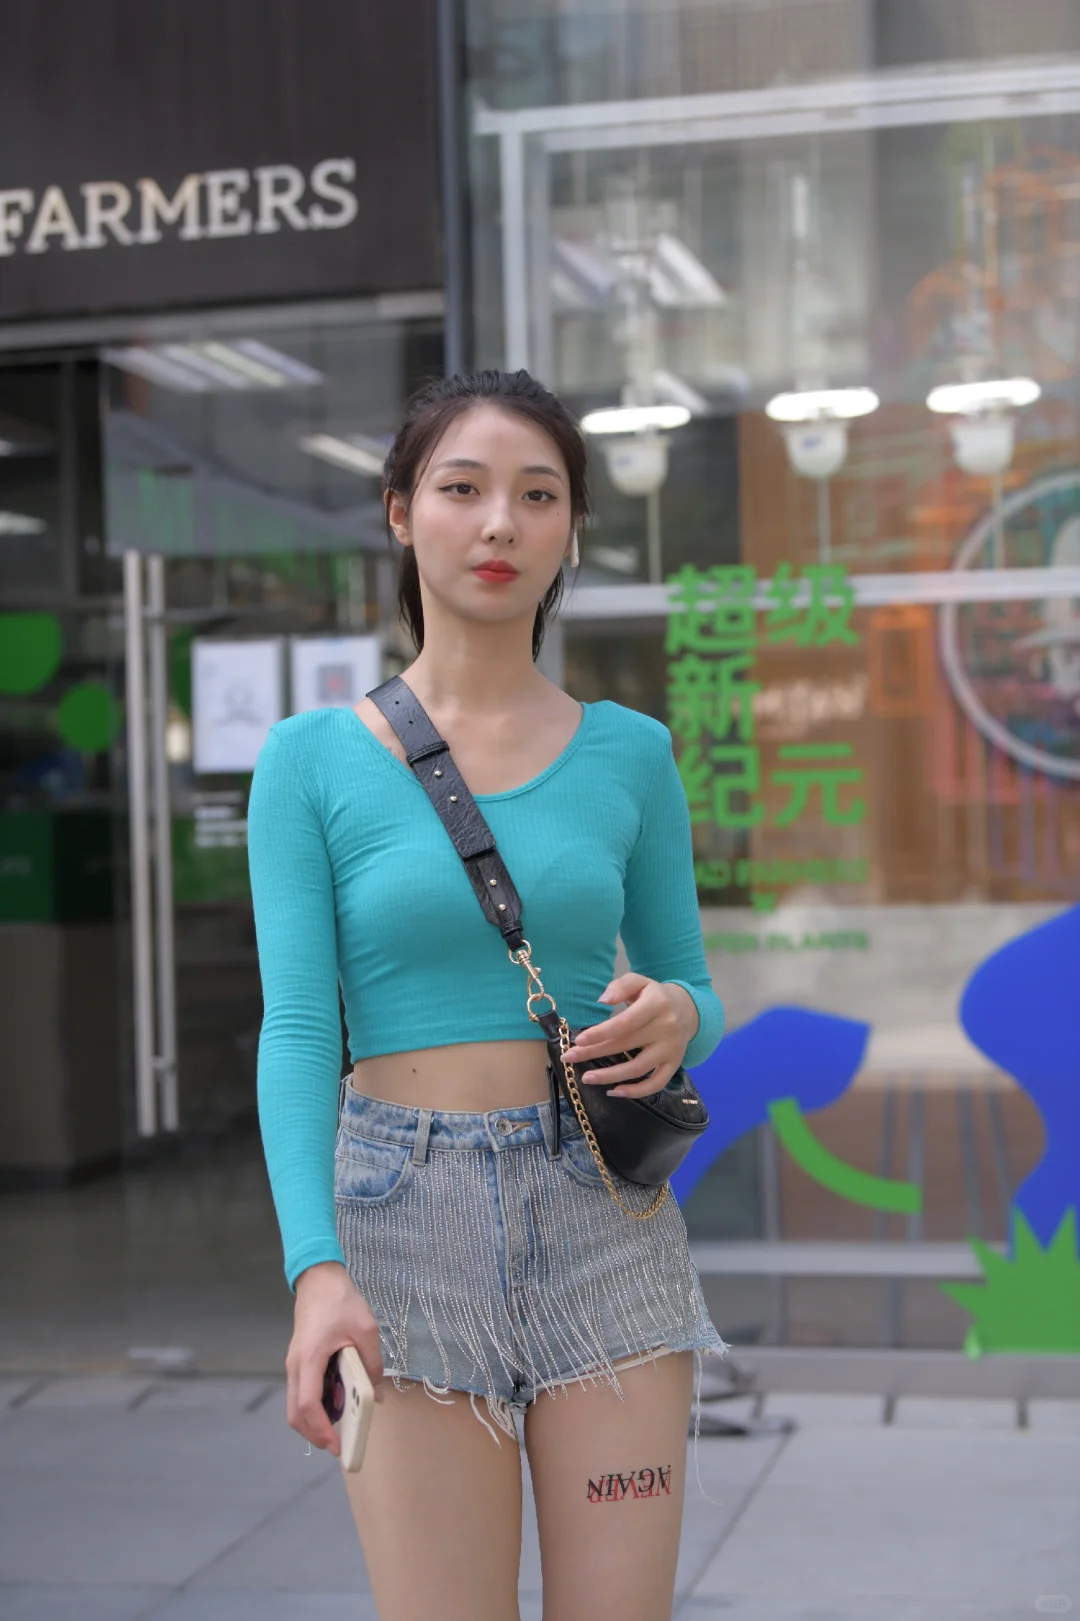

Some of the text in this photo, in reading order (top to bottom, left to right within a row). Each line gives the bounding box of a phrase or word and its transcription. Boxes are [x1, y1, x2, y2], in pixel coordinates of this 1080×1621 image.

[0, 156, 358, 257] FARMERS
[665, 562, 860, 654] 超级
[665, 653, 763, 741] 新
[676, 742, 867, 830] 纪元
[586, 1465, 671, 1498] AGAIN
